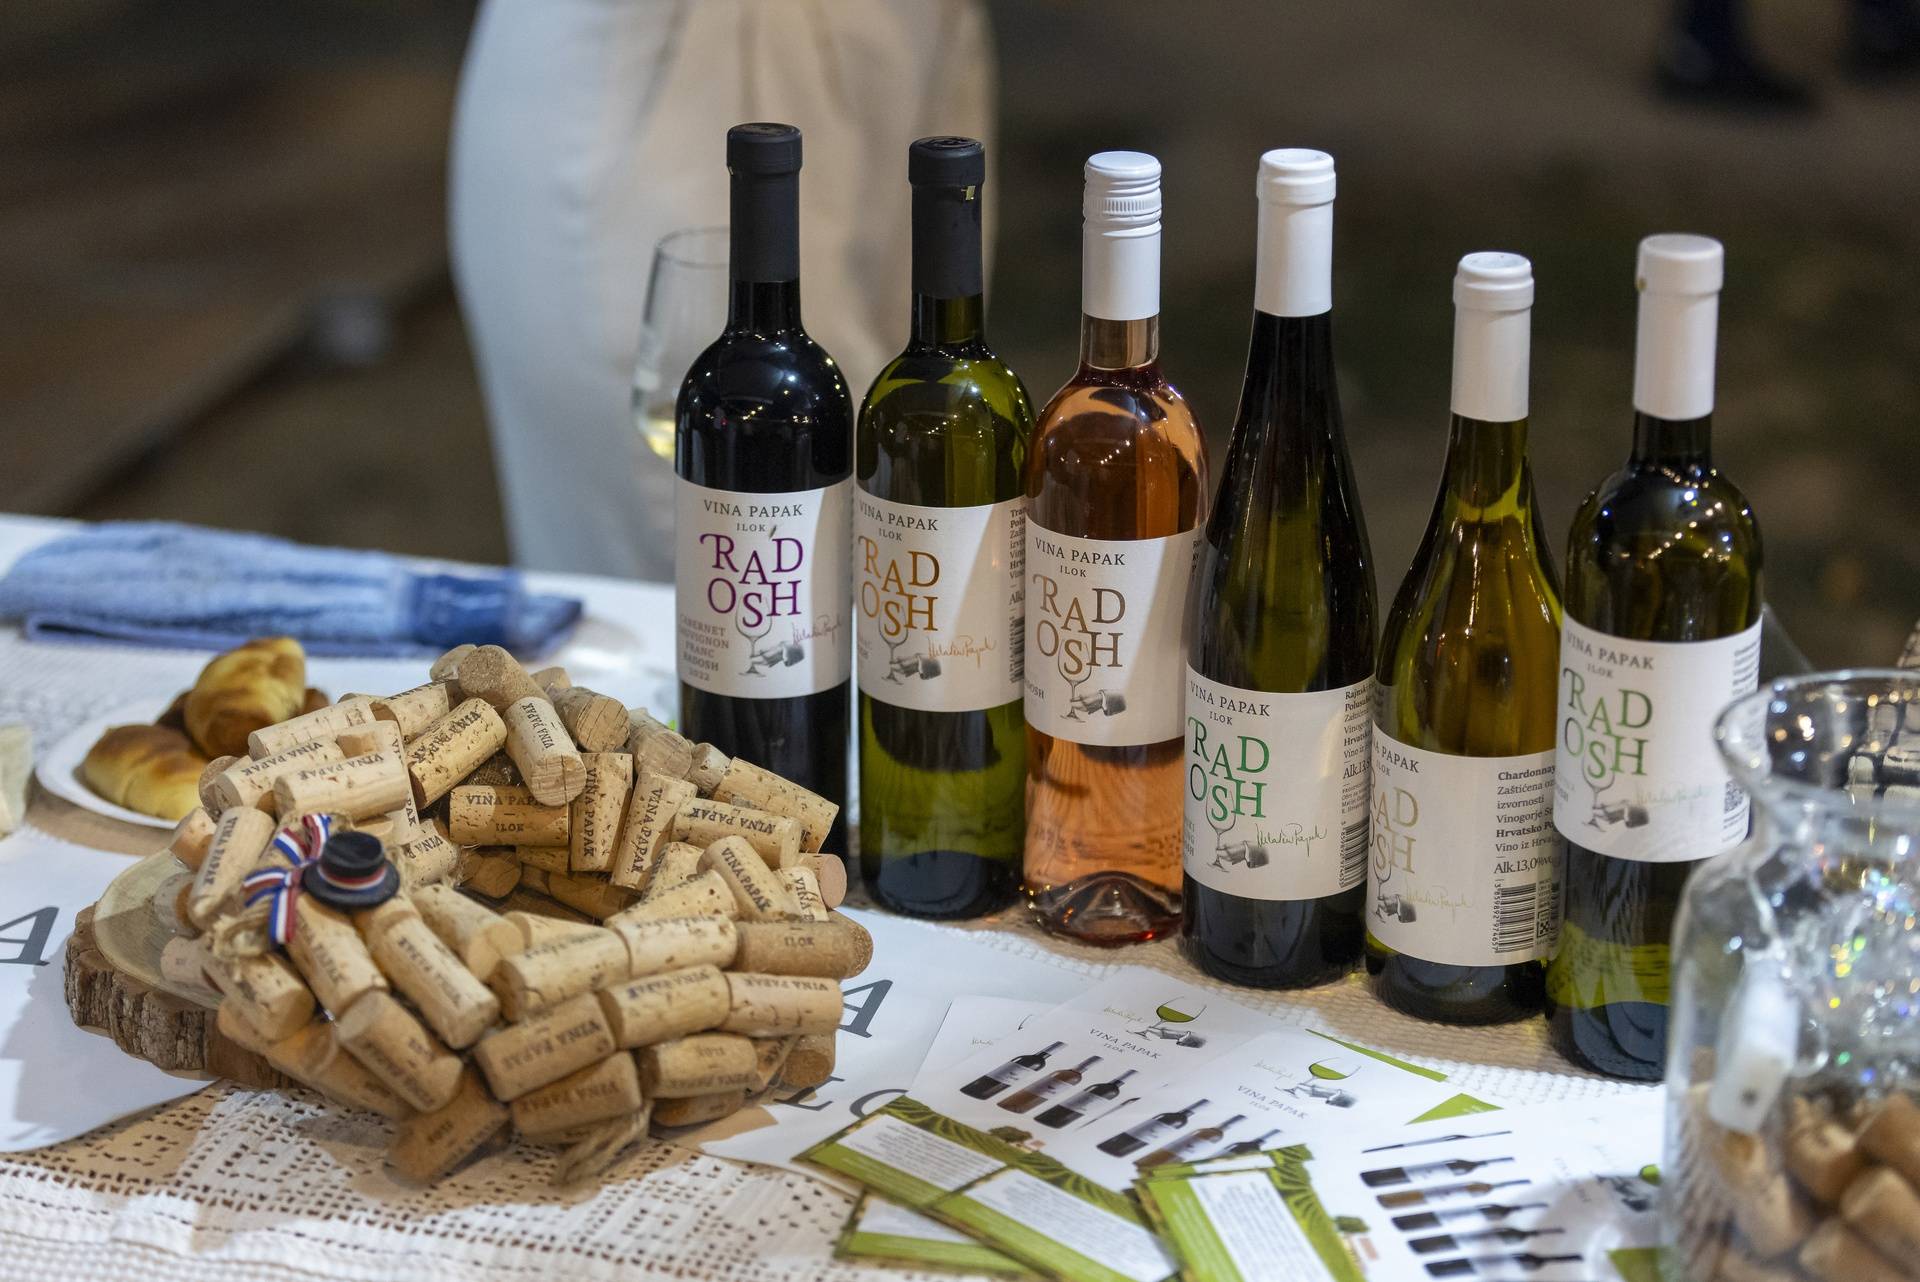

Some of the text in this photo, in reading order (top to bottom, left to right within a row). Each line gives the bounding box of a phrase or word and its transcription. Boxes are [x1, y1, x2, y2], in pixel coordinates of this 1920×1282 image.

[703, 499, 803, 518] VINA PAPAK
[859, 501, 939, 532] VINA PAPAK
[736, 522, 766, 533] ILOK
[878, 527, 903, 541] ILOK
[1035, 537, 1126, 566] VINA PAPAK
[1060, 564, 1087, 578] ILOK
[1566, 631, 1654, 670] VINA PAPAK
[1587, 664, 1614, 679] ILOK
[1190, 680, 1271, 717] VINA PAPAK
[521, 702, 554, 749] VINA PAPAK
[1209, 710, 1233, 726] ILOK
[240, 741, 323, 777] VINA PAPAK
[299, 752, 384, 781] VINA PAPAK
[1382, 745, 1419, 774] PAPAK
[1498, 765, 1556, 781] Chardonnay
[465, 794, 541, 805] VINA PAP
[1497, 783, 1543, 795] Zaštićena
[1497, 794, 1545, 810] izvornosti
[581, 767, 598, 857] VINA PAPAK
[642, 788, 663, 827] VINA
[690, 806, 776, 835] VINA PAPAK
[1496, 811, 1543, 824] Vinogorje
[220, 816, 239, 844] VINA
[496, 822, 525, 832] ILOK
[1496, 824, 1542, 838] Hrvatsko
[414, 834, 444, 857] VINA
[630, 828, 653, 874] PAPAK
[1495, 843, 1519, 852] Vino
[1521, 840, 1529, 850] iz
[721, 847, 744, 879] VINA
[739, 875, 771, 912] PAPAK
[793, 876, 812, 912] VINA
[792, 980, 829, 991] VINA
[1089, 1028, 1162, 1059] VINA PAPAK
[1238, 1085, 1309, 1119] VINA PAPAK
